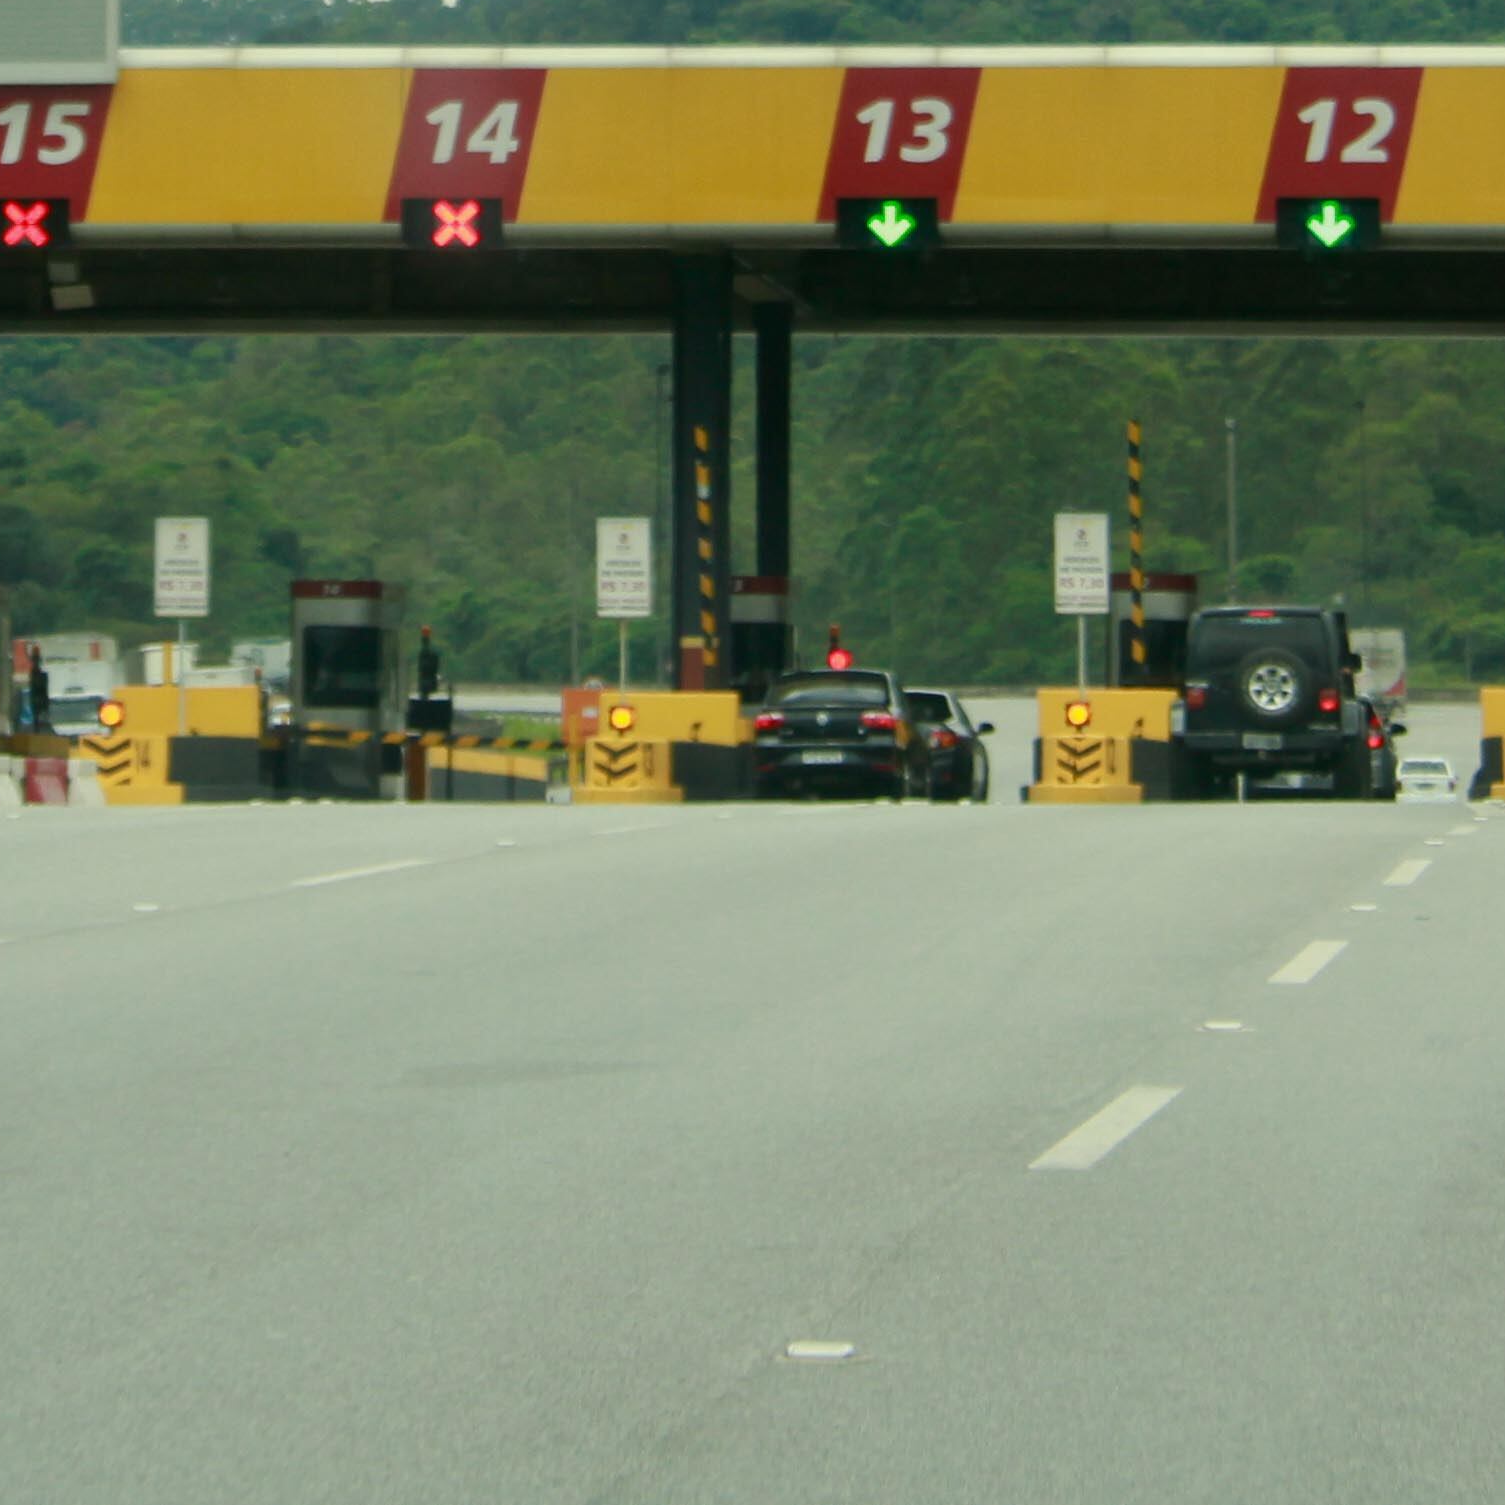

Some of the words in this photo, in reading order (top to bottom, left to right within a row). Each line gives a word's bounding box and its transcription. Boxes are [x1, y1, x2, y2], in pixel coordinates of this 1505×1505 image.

[425, 101, 519, 164] 14
[857, 99, 952, 163] 13
[1299, 99, 1395, 163] 12
